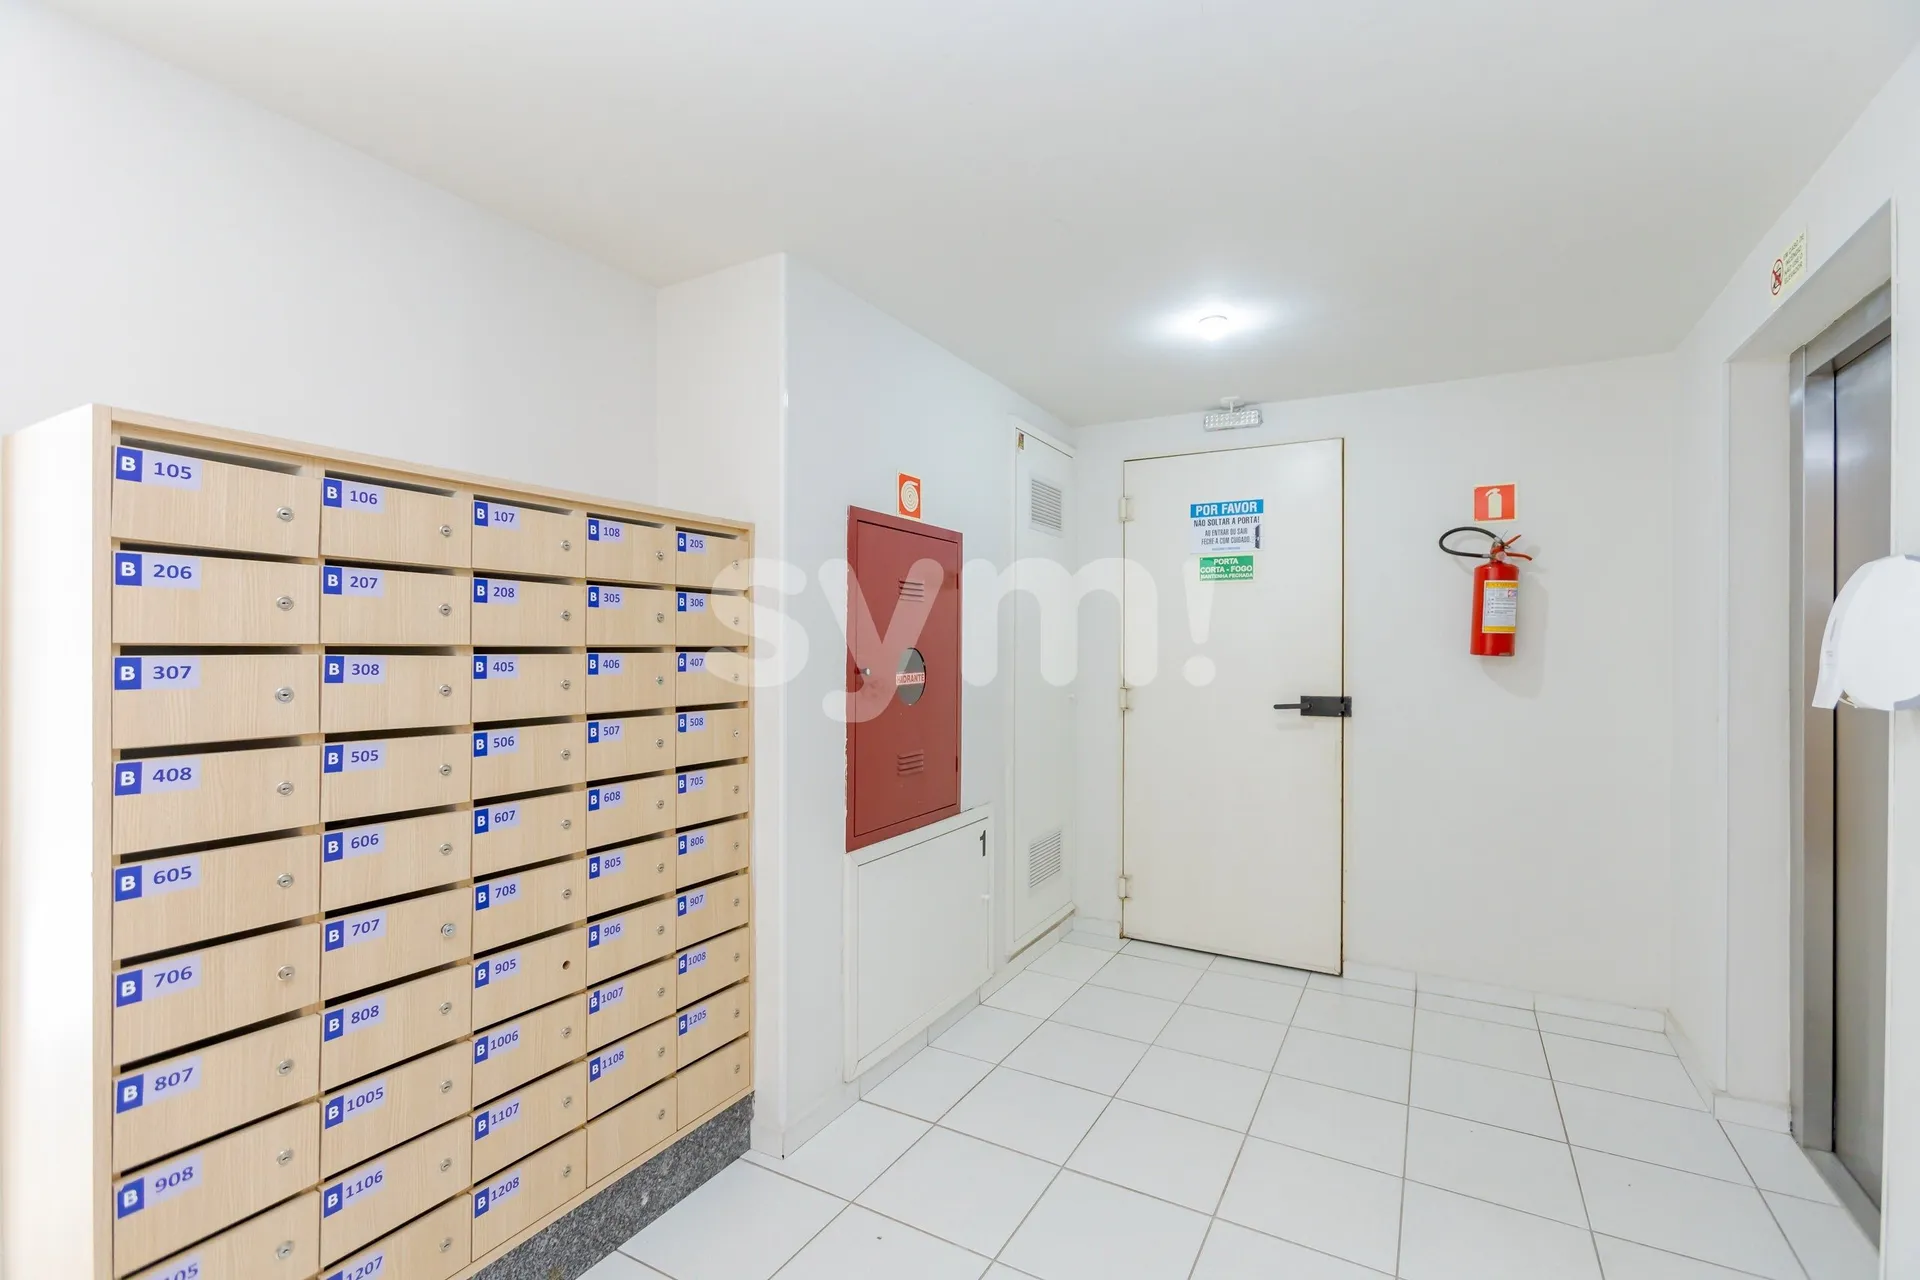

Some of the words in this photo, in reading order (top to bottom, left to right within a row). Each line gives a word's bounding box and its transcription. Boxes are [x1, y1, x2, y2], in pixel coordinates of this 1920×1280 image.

[121, 455, 136, 470] B
[154, 462, 191, 479] 105
[327, 487, 338, 499] B
[350, 490, 378, 505] 106
[477, 509, 485, 519] B
[495, 511, 514, 522] 107
[1196, 505, 1218, 516] POR
[1222, 502, 1257, 514] FAVOR
[1208, 518, 1230, 526] SOLTAR
[1238, 516, 1259, 524] PORTA!
[590, 525, 597, 535] B
[604, 527, 620, 537] 108
[679, 538, 684, 547] B
[690, 539, 703, 548] 205
[121, 562, 136, 576] B
[154, 564, 192, 579] 206
[327, 575, 338, 586] B
[350, 576, 378, 589] 207
[477, 586, 485, 596] B
[494, 587, 514, 597] 208
[590, 593, 597, 601] B
[604, 593, 620, 603] 305
[679, 598, 684, 606] B
[690, 598, 703, 607] 306
[329, 664, 339, 675] B
[352, 664, 379, 675] 308
[476, 663, 484, 672] B
[493, 662, 514, 672] 405
[590, 660, 596, 668] B
[603, 660, 619, 668] 406
[679, 658, 684, 667] B
[690, 658, 703, 666] 407
[120, 666, 135, 681] B
[153, 666, 191, 679] 307
[679, 718, 685, 727] B
[690, 718, 703, 726] 508
[590, 728, 597, 737] B
[604, 726, 619, 736] 507
[476, 739, 484, 749] B
[494, 736, 514, 748] 506
[328, 753, 338, 765] B
[351, 750, 378, 762] 505
[120, 771, 135, 786] B
[153, 767, 191, 782] 408
[679, 780, 684, 788] B
[690, 776, 703, 786] 705
[590, 795, 597, 804] B
[604, 791, 620, 802] 608
[478, 816, 485, 826] B
[495, 810, 515, 823] 607
[328, 841, 339, 853] B
[351, 834, 378, 848] 606
[679, 840, 685, 849] B
[690, 836, 704, 846] 806
[980, 830, 986, 857] 1
[591, 863, 597, 872] B
[605, 857, 621, 869] 805
[121, 876, 136, 891] B
[154, 866, 191, 884] 605
[478, 892, 486, 902] B
[495, 884, 516, 898] 708
[679, 902, 684, 910] B
[690, 895, 703, 906] 907
[329, 929, 339, 942] B
[352, 919, 379, 936] 707
[590, 931, 597, 940] B
[604, 924, 620, 936] 906
[679, 960, 685, 969] B
[688, 952, 706, 966] 1008
[478, 969, 486, 979] B
[495, 959, 516, 974] 905
[121, 981, 137, 996] B
[154, 966, 192, 987] 706
[590, 997, 597, 1007] B
[602, 988, 623, 1003] 1007
[329, 1019, 340, 1031] B
[351, 1005, 379, 1024] 808
[680, 1021, 685, 1029] B
[689, 1011, 706, 1025] 1205
[477, 1045, 485, 1055] B
[491, 1031, 518, 1050] 1006
[592, 1065, 599, 1074] B
[602, 1052, 624, 1068] 1108
[123, 1085, 138, 1102] B
[155, 1068, 193, 1091] 807
[329, 1106, 339, 1119] B
[347, 1087, 384, 1112] 1005
[478, 1120, 486, 1130] B
[492, 1104, 519, 1124] 1107
[123, 1189, 138, 1207] B
[155, 1166, 194, 1193] 908
[327, 1194, 338, 1207] B
[346, 1171, 383, 1198] 1106
[478, 1197, 485, 1207] B
[492, 1178, 520, 1201] 1208
